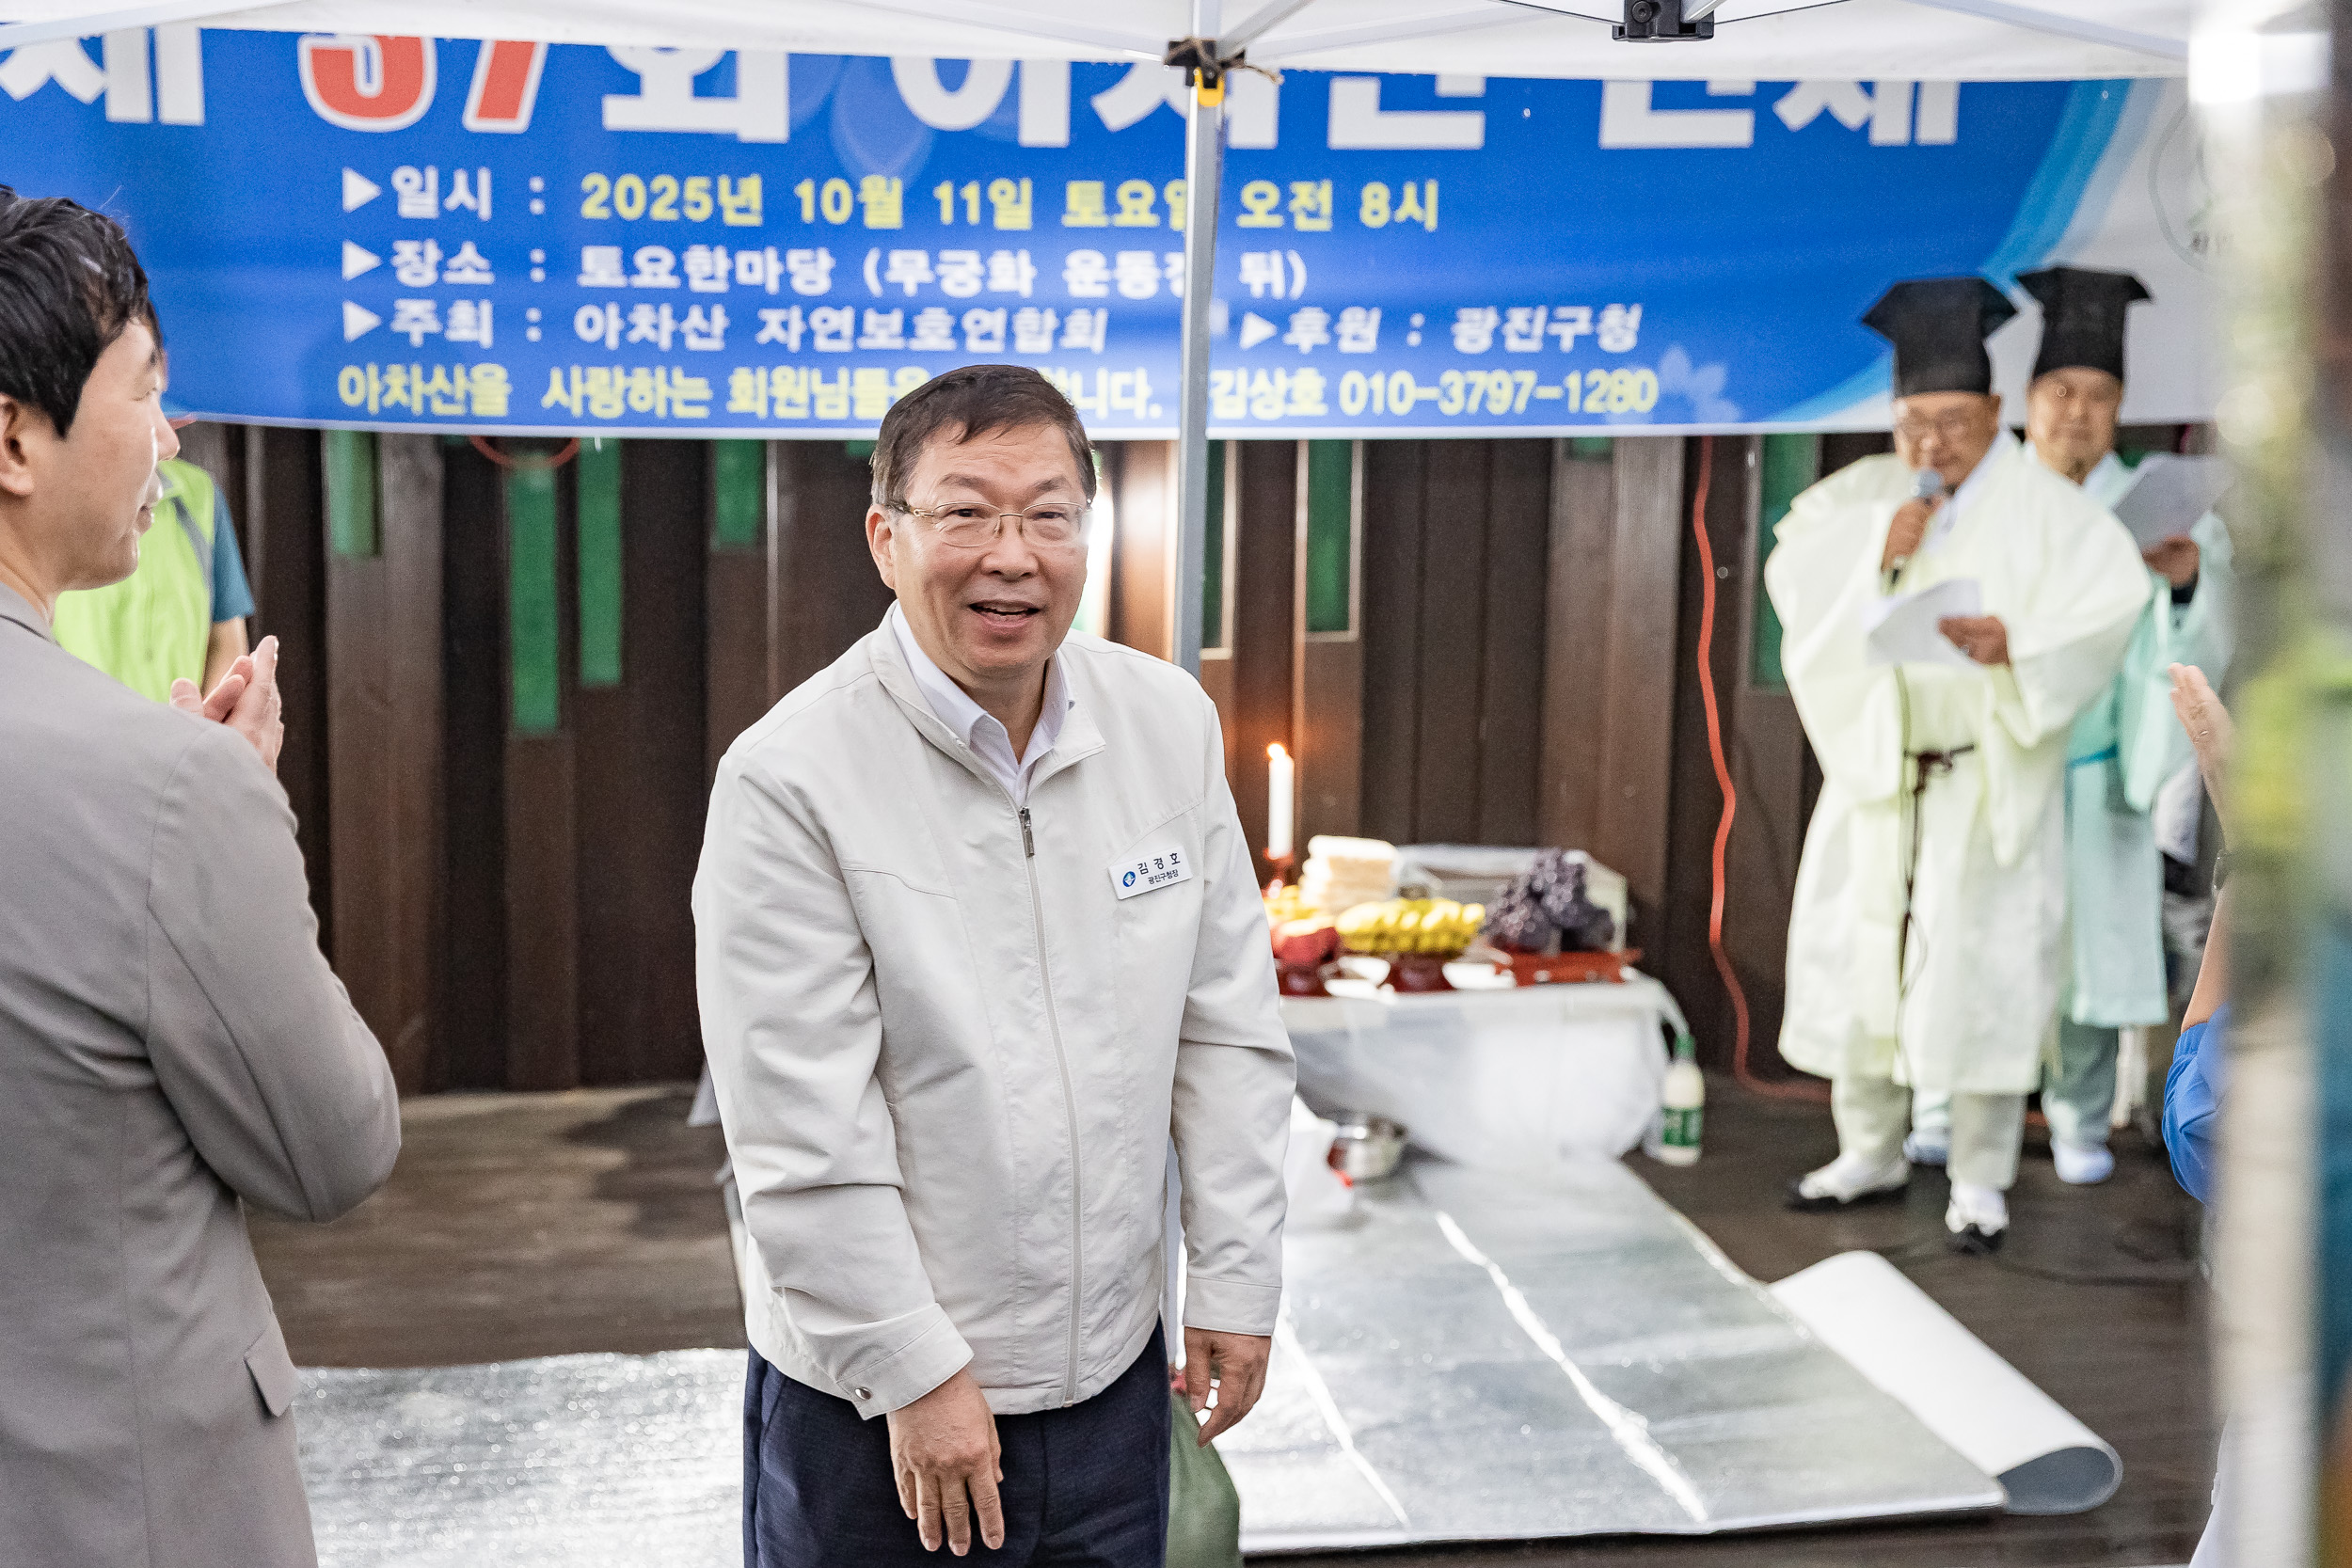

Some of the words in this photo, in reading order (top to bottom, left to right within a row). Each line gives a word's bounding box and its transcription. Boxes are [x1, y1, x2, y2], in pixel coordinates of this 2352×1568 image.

[390, 165, 492, 222] 일시
[580, 172, 763, 227] 2025년
[793, 174, 903, 230] 10월
[932, 177, 1034, 231] 11일
[1236, 179, 1333, 232] 오전
[1359, 178, 1439, 233] 8시
[390, 239, 496, 288] 장소
[577, 244, 836, 297] 토요한마당
[573, 302, 731, 352] 아차산
[755, 305, 1109, 355] 자연보호연합회
[1282, 306, 1382, 355] 후원
[1450, 303, 1645, 355] 광진구청
[337, 361, 513, 418] 아차산을
[540, 363, 713, 420] 사랑하는
[1148, 869, 1179, 884] 광진구청장
